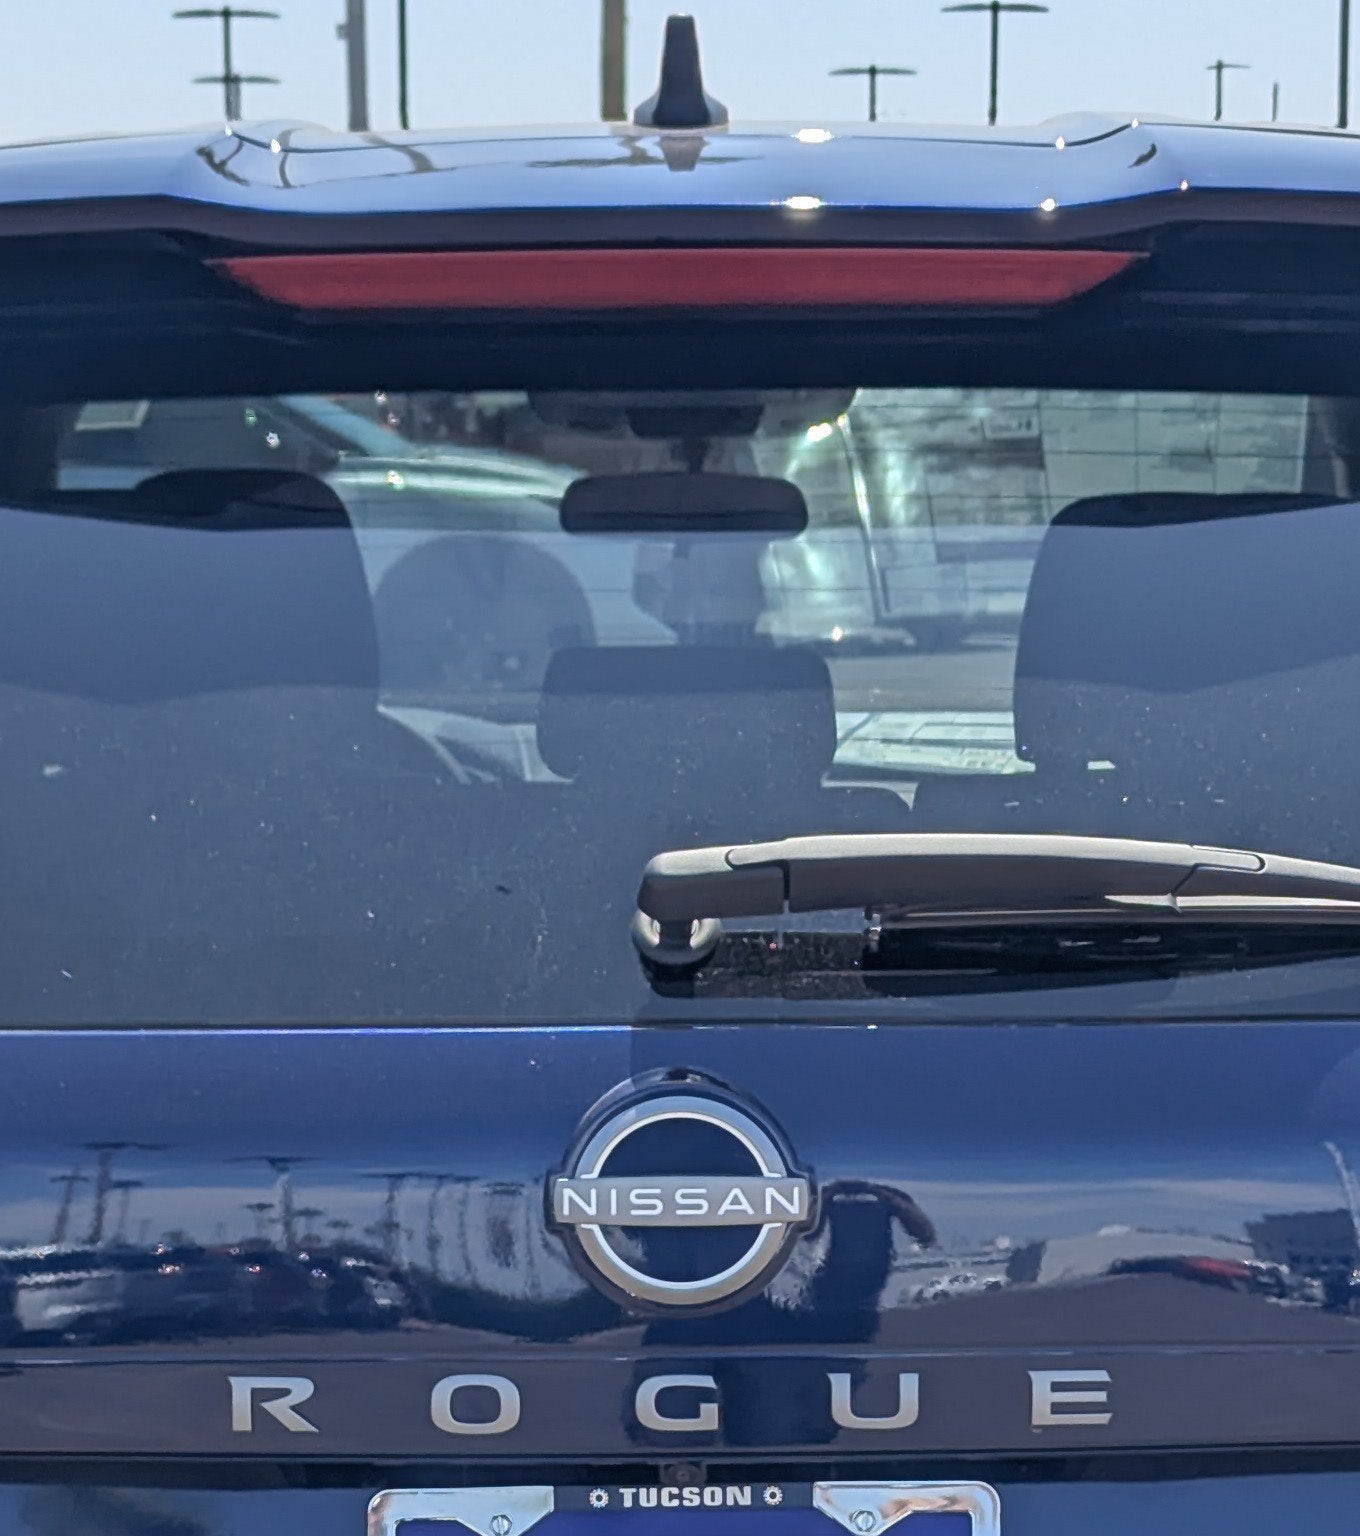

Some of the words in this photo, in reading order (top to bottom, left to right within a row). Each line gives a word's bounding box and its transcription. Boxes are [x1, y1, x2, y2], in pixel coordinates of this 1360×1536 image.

[561, 1186, 801, 1216] NISSAN
[228, 1369, 1114, 1436] ROGUE
[619, 1486, 753, 1508] TUCSON
